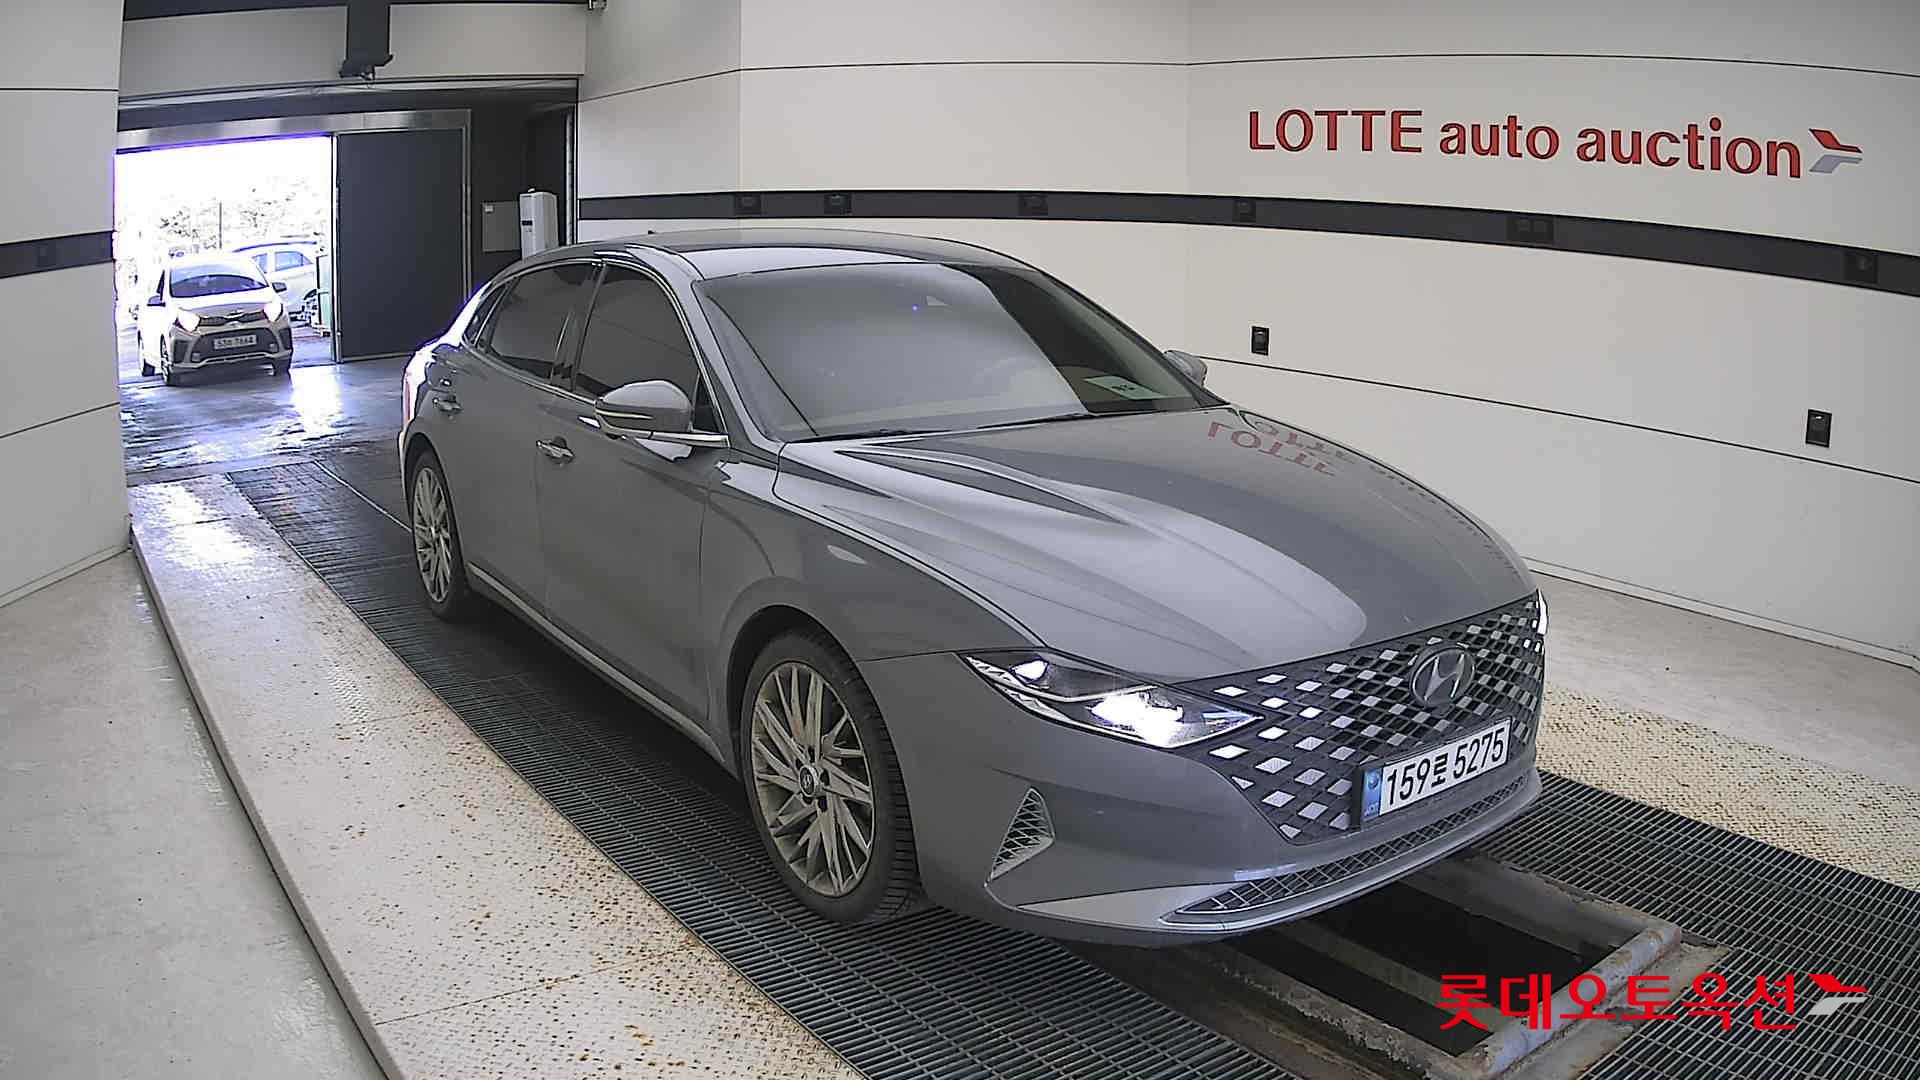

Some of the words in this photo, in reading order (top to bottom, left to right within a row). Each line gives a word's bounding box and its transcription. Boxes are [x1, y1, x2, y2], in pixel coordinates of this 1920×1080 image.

[1249, 109, 1422, 154] LOTTE
[1439, 115, 1560, 160] auto
[1575, 116, 1802, 178] auction
[1386, 752, 1449, 805] 159로
[1453, 727, 1506, 779] 5275
